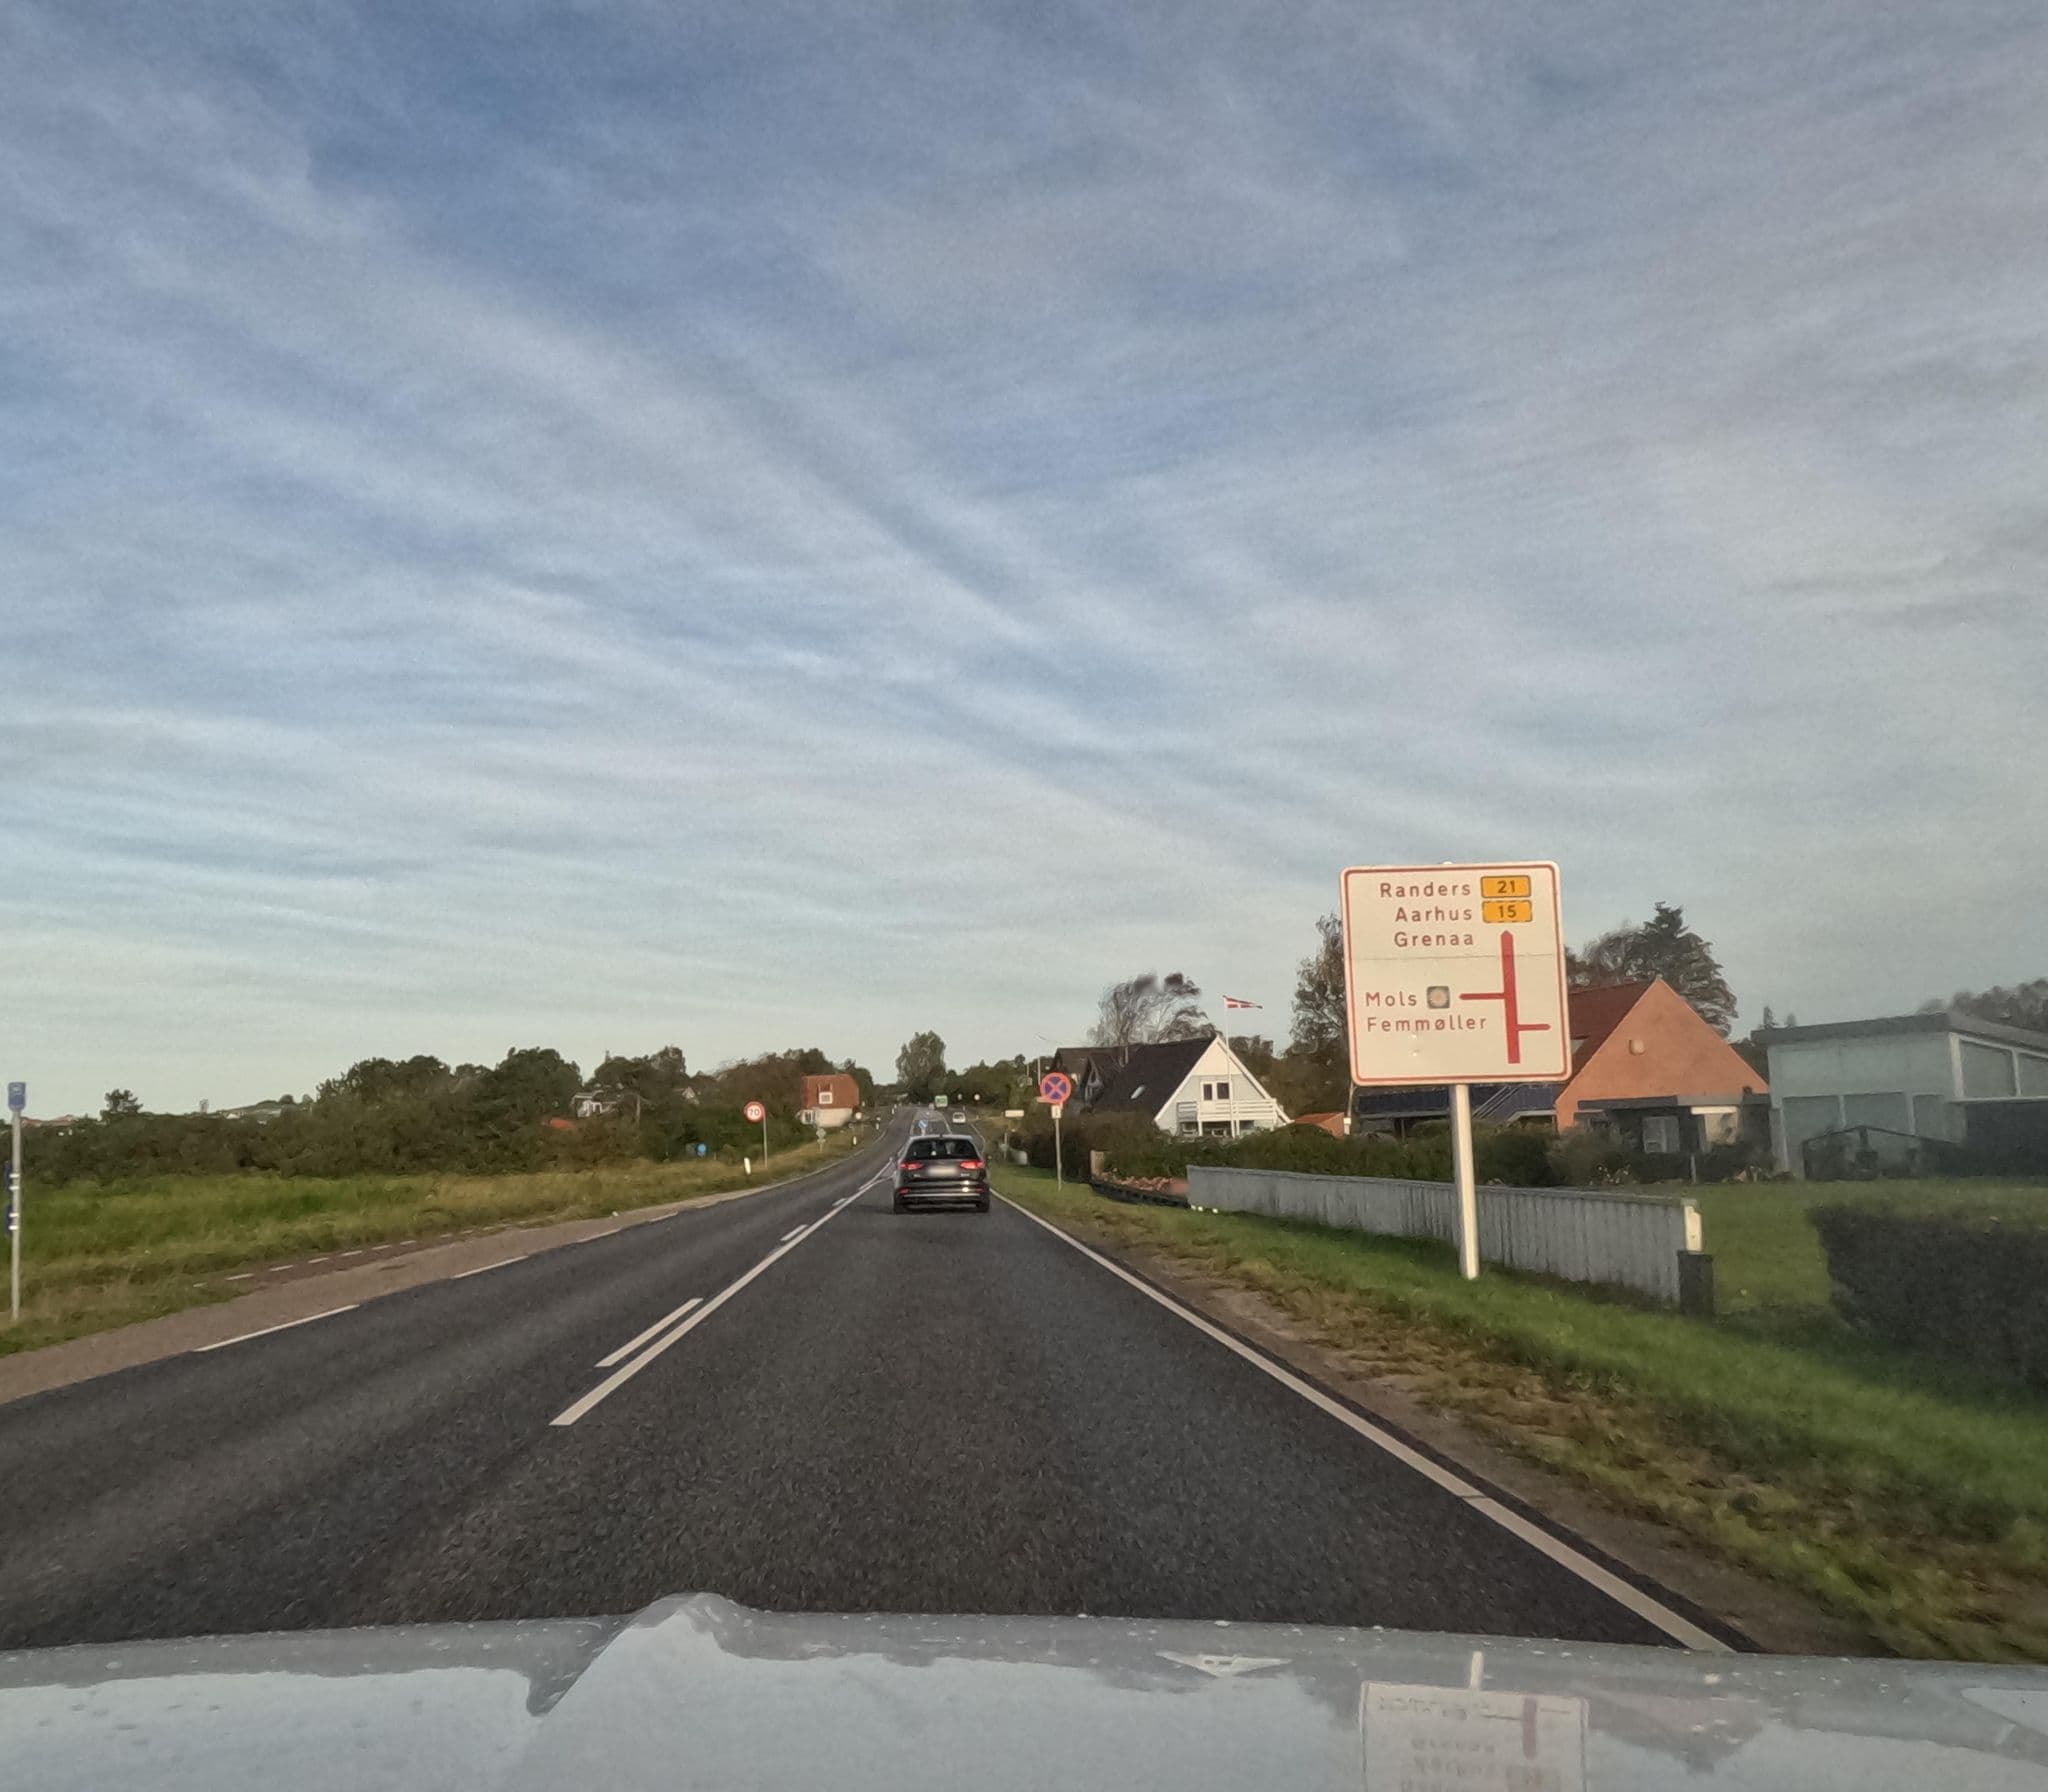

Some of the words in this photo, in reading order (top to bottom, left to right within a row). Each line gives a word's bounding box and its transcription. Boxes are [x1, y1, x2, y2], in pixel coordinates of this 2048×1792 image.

[1380, 882, 1471, 898] Randers
[1497, 880, 1516, 894] 21
[1395, 906, 1473, 922] Aarhus
[1499, 905, 1517, 918] 15
[1394, 931, 1474, 947] Grenaa
[1365, 991, 1417, 1007] Mols
[1367, 1015, 1487, 1032] Femmøller
